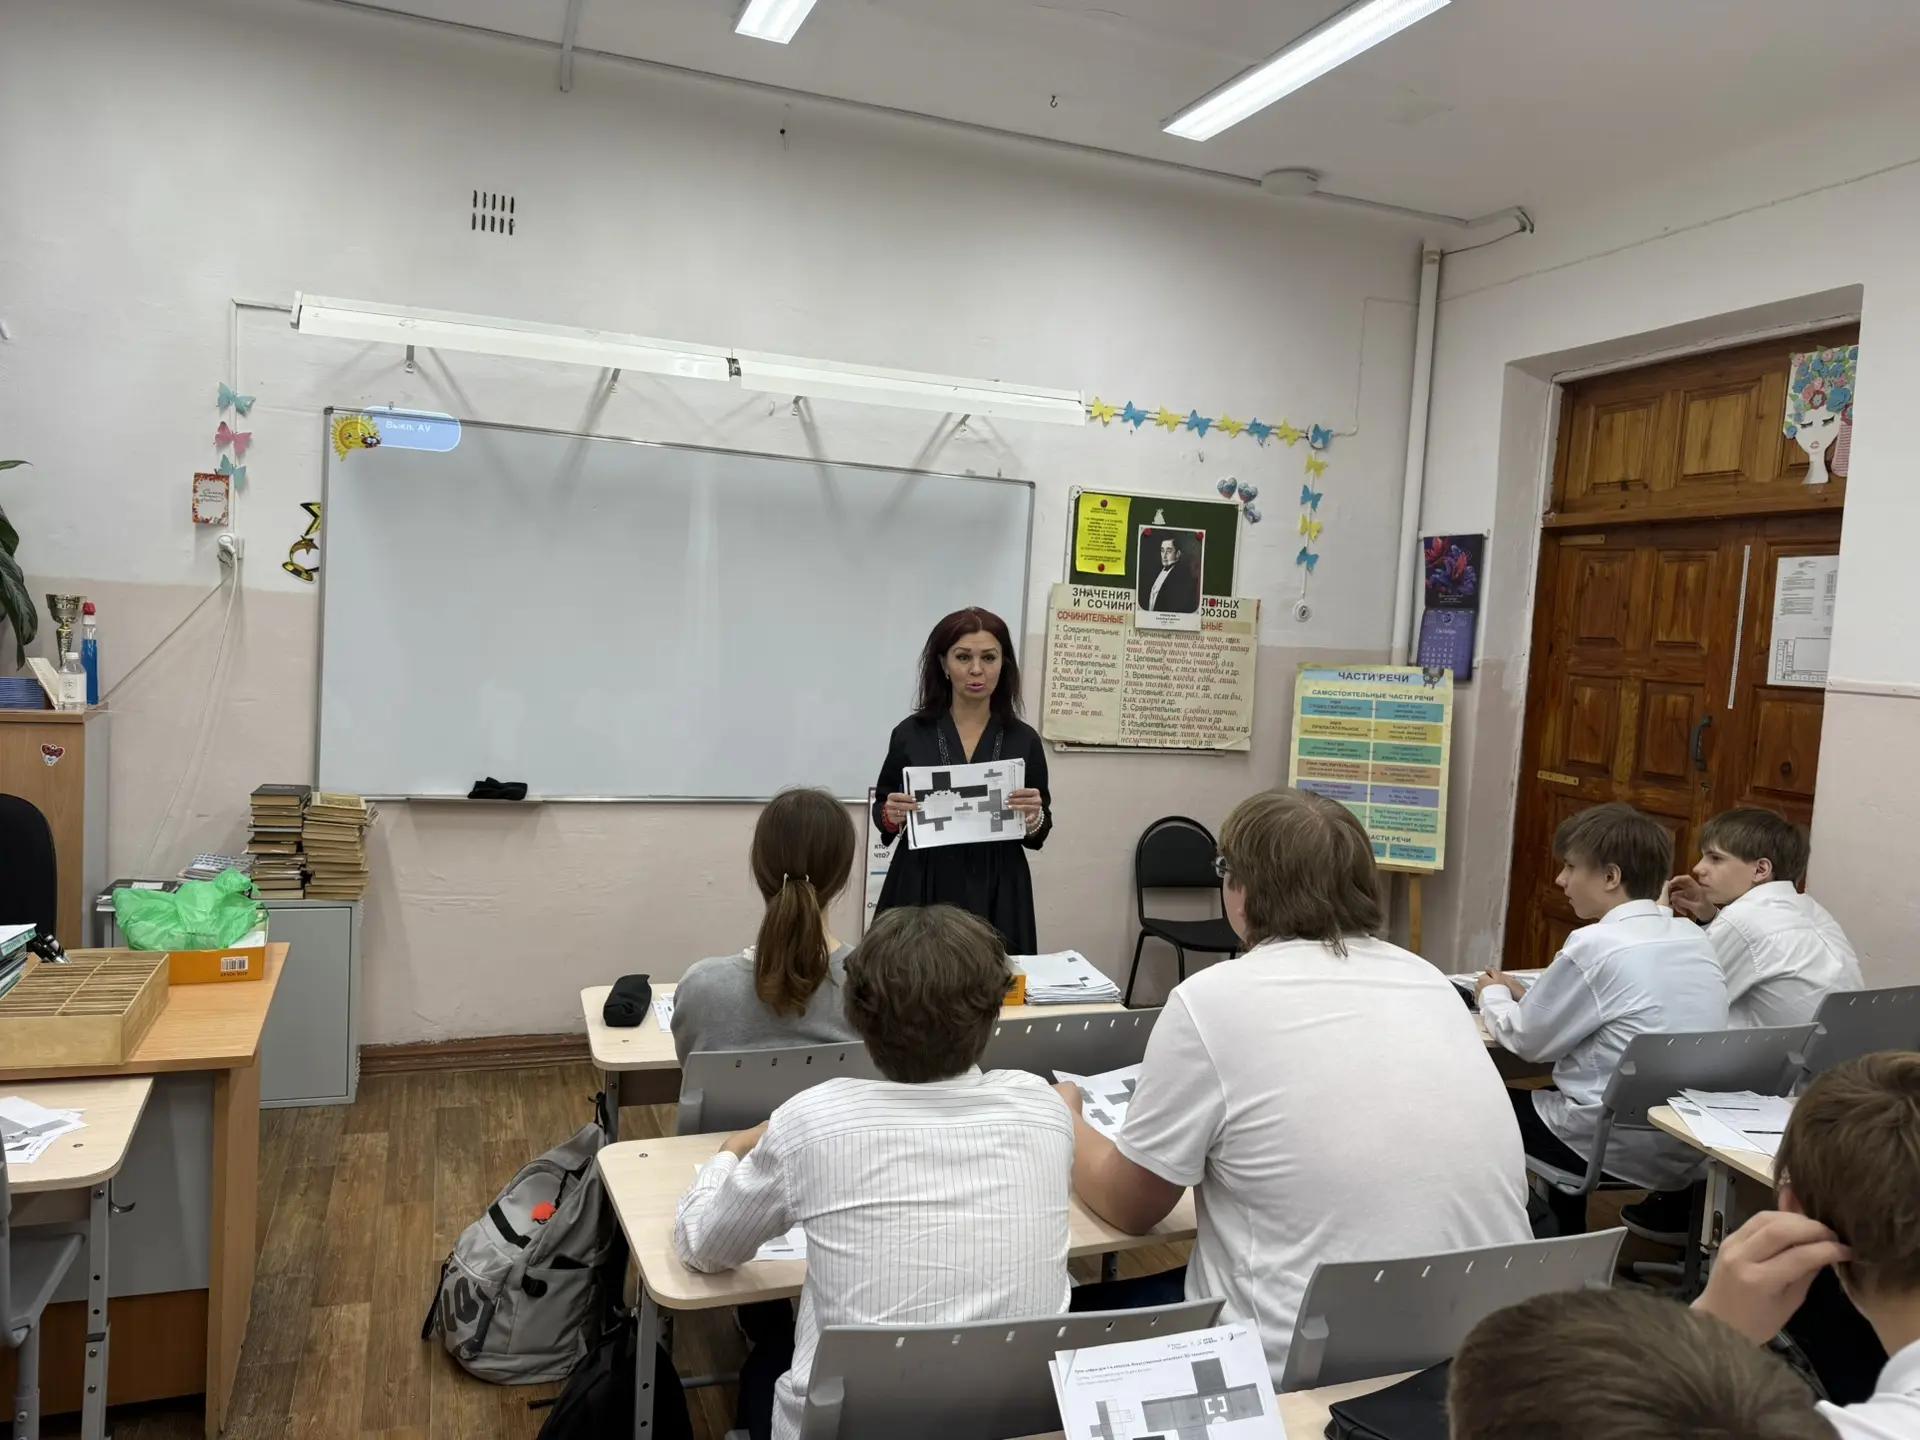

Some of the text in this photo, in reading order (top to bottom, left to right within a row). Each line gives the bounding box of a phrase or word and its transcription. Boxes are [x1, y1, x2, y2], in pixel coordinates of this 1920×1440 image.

[1072, 587, 1131, 600] ЗНАЧЕНИЯ
[1073, 597, 1080, 607] И
[1056, 610, 1125, 624] СОЧИНИТЕЛЬНЫЕ
[1338, 671, 1410, 683] ЧАСТИ РЕЧИ
[1311, 689, 1435, 702] САМОСТОЯТЕЛЬНЫЕ ЧАСТИ РЕЧИ
